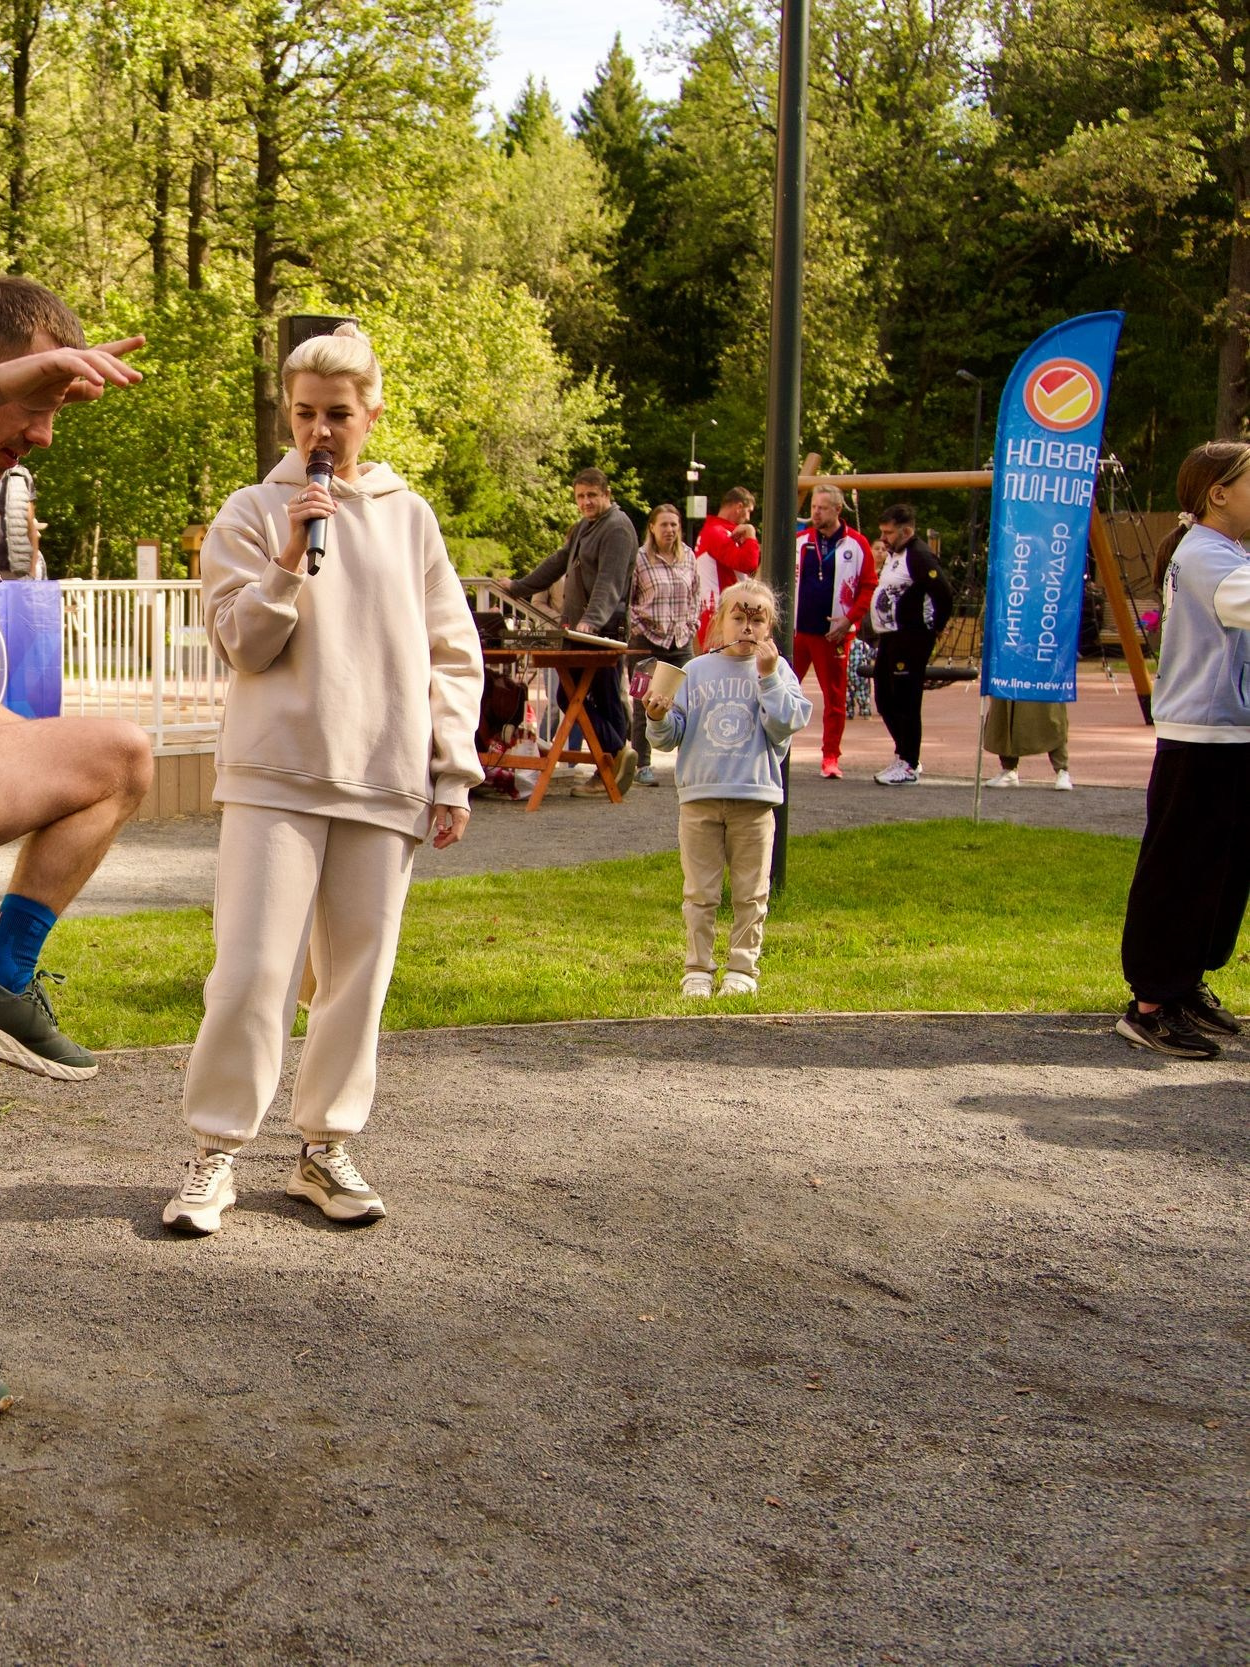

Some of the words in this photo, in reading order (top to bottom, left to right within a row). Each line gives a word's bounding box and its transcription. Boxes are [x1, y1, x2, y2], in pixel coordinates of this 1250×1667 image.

[1002, 473, 1094, 508] ЛИНИЯ
[1004, 532, 1032, 647] интернет
[1036, 522, 1072, 662] провайдер
[688, 677, 758, 710] SENSATIO
